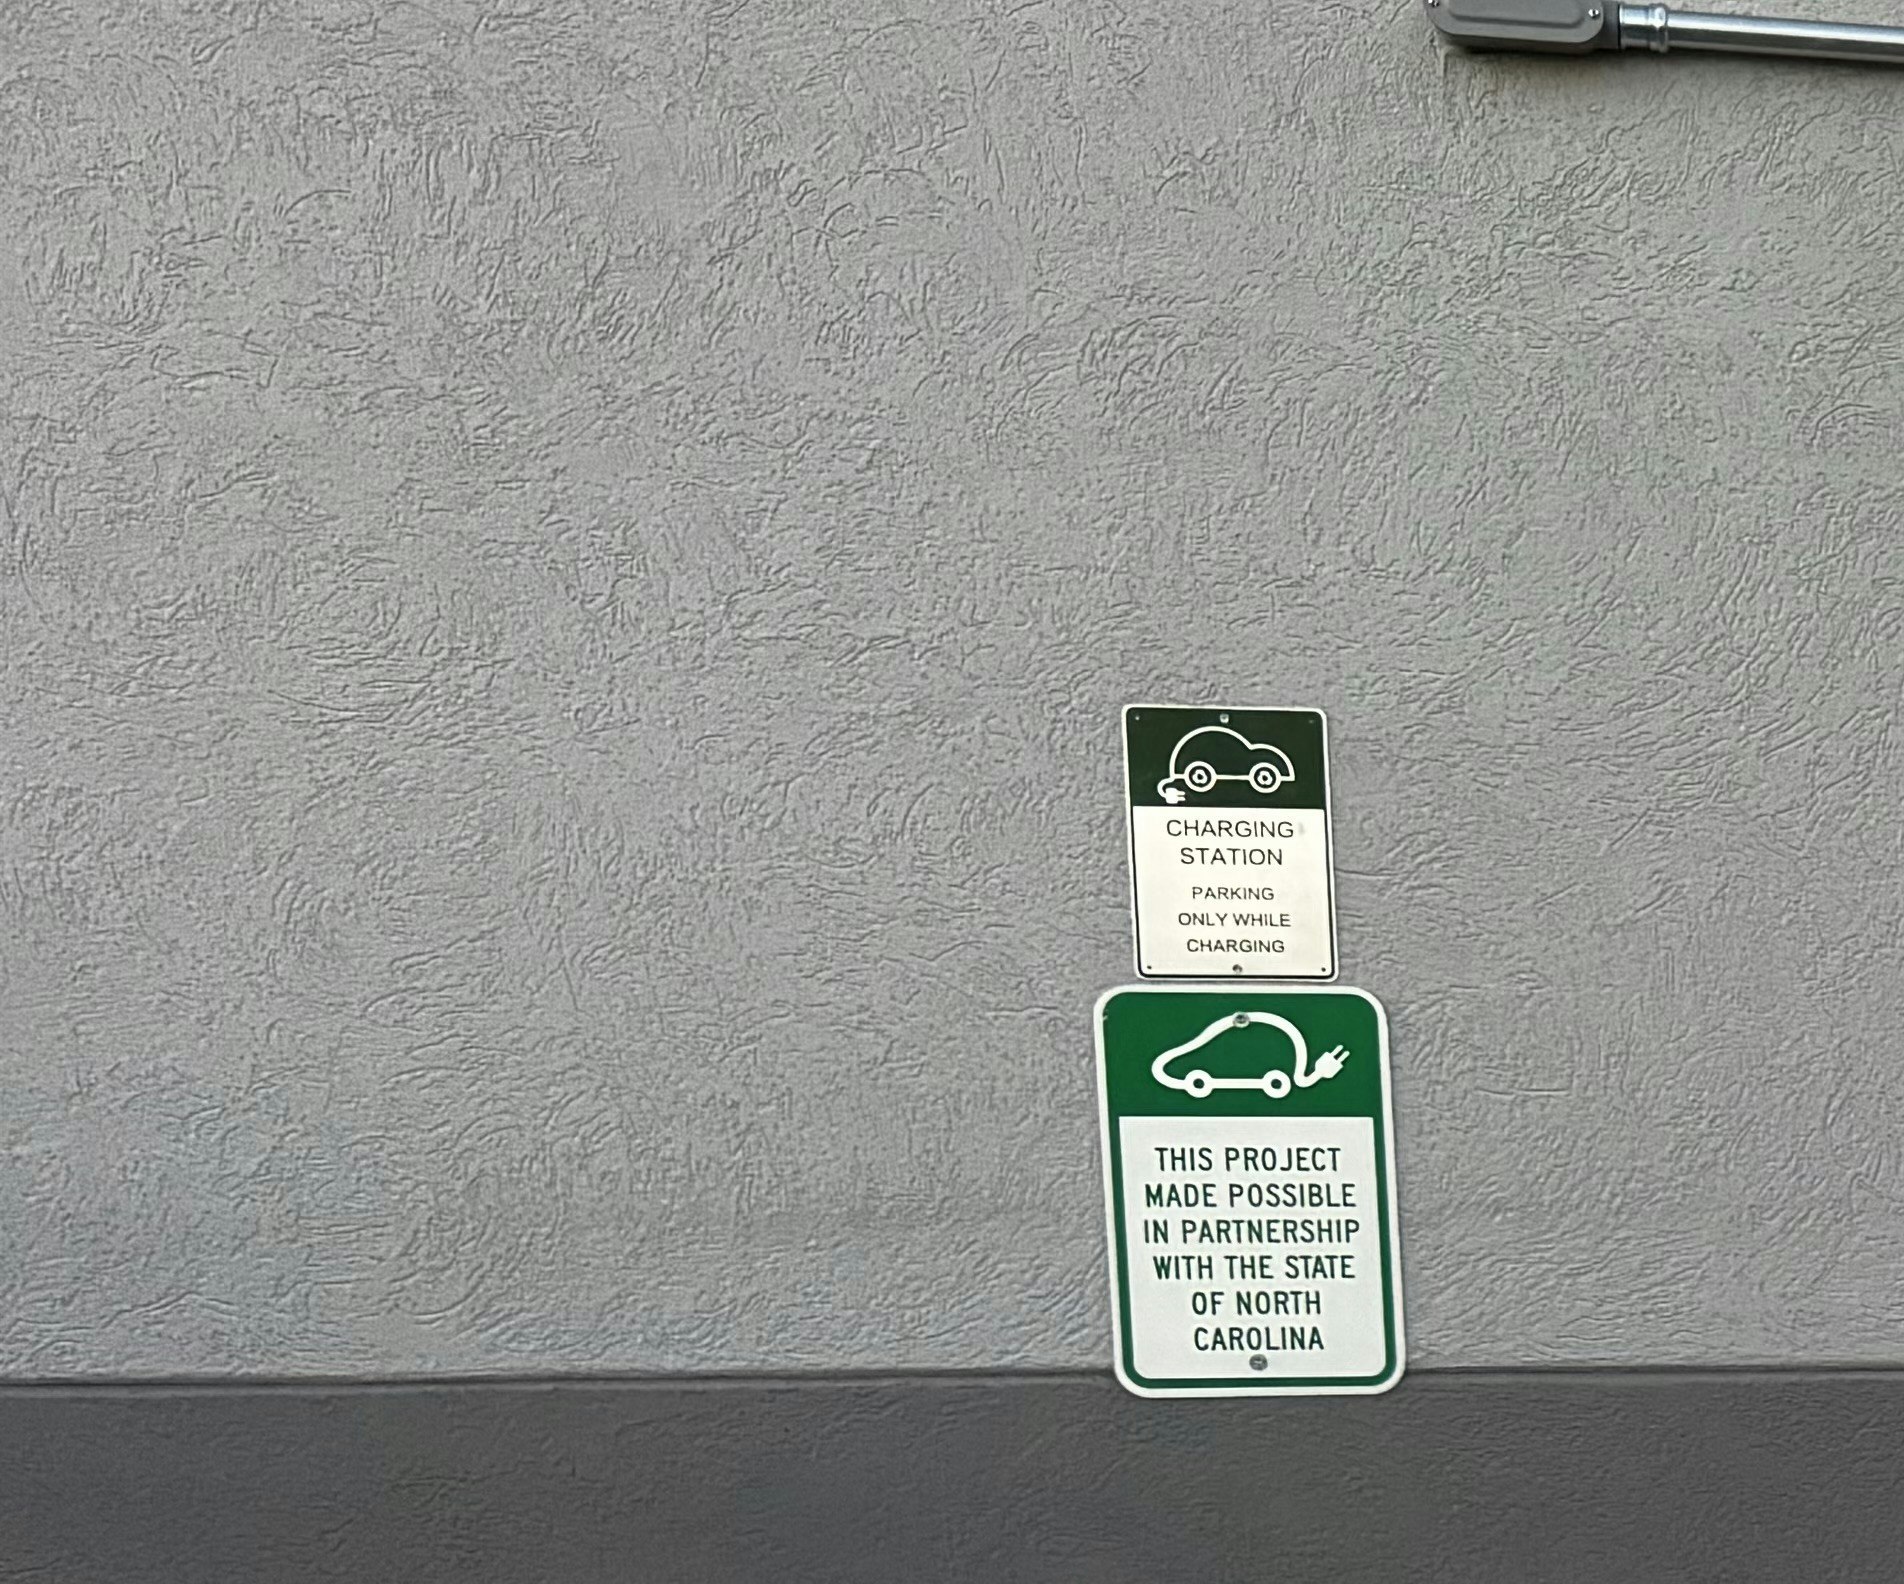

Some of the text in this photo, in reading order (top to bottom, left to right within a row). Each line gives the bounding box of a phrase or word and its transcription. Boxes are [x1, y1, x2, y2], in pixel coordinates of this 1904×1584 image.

[1167, 820, 1293, 838] CHARGING
[1181, 848, 1282, 865] STATION
[1192, 887, 1274, 900] PARKING
[1179, 913, 1291, 927] ONLY WHILE
[1187, 939, 1284, 953] CHARGING
[1155, 1147, 1341, 1171] THIS PROJECT
[1145, 1183, 1356, 1207] MADE POSSIBLE
[1144, 1219, 1359, 1244] IN PARTNERSHIP
[1153, 1255, 1355, 1280] WITH THE STATE
[1192, 1291, 1320, 1315] OF NORTH
[1194, 1327, 1324, 1351] CAROLINA
